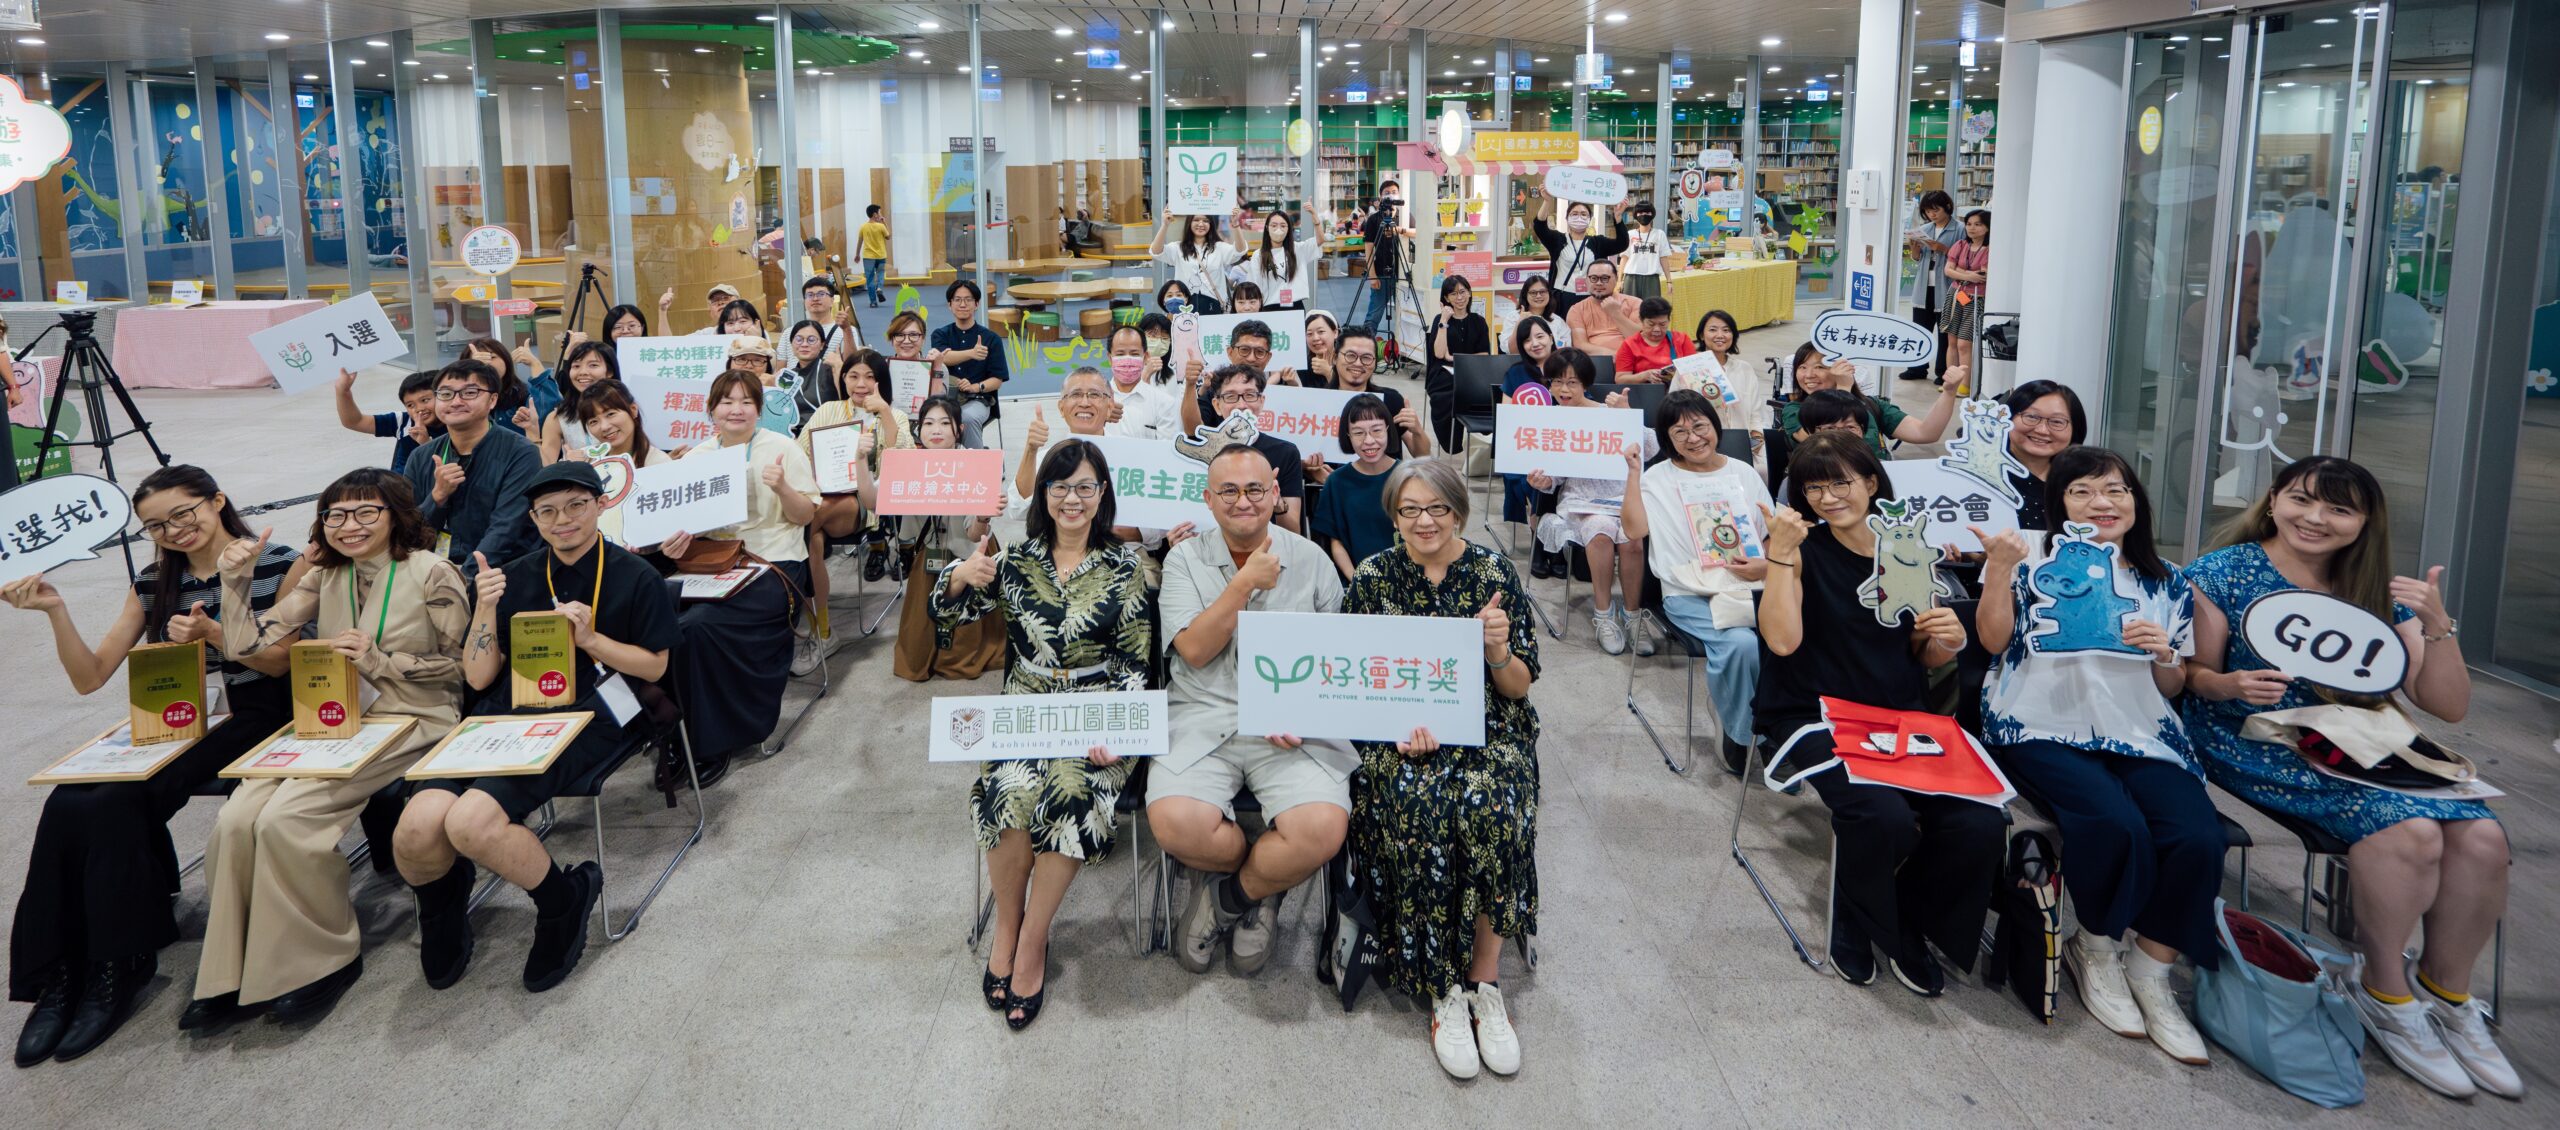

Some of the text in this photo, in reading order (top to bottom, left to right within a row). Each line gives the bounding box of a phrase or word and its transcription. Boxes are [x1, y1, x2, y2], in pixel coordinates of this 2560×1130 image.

[325, 319, 380, 357] 入選
[1203, 330, 1291, 355] 購助
[1821, 325, 1924, 356] 我有好繪本!
[640, 345, 724, 363] 繪本的種籽
[656, 364, 708, 380] 在發芽
[663, 391, 710, 414] 揮灑
[1256, 410, 1341, 438] 國內外推
[1514, 426, 1625, 456] 保證出版
[636, 474, 730, 516] 特別推薦
[891, 480, 988, 496] 國際繪本中心
[1109, 466, 1209, 504] 限主題
[1890, 492, 1992, 523] 媒合會
[2274, 613, 2385, 678] GO!
[1319, 655, 1458, 693] 好繪芽獎
[1390, 696, 1425, 704] SPROUTING
[992, 701, 1150, 735] 高雄市立圖書館
[991, 736, 1150, 749] Kaohsiung Public Library
